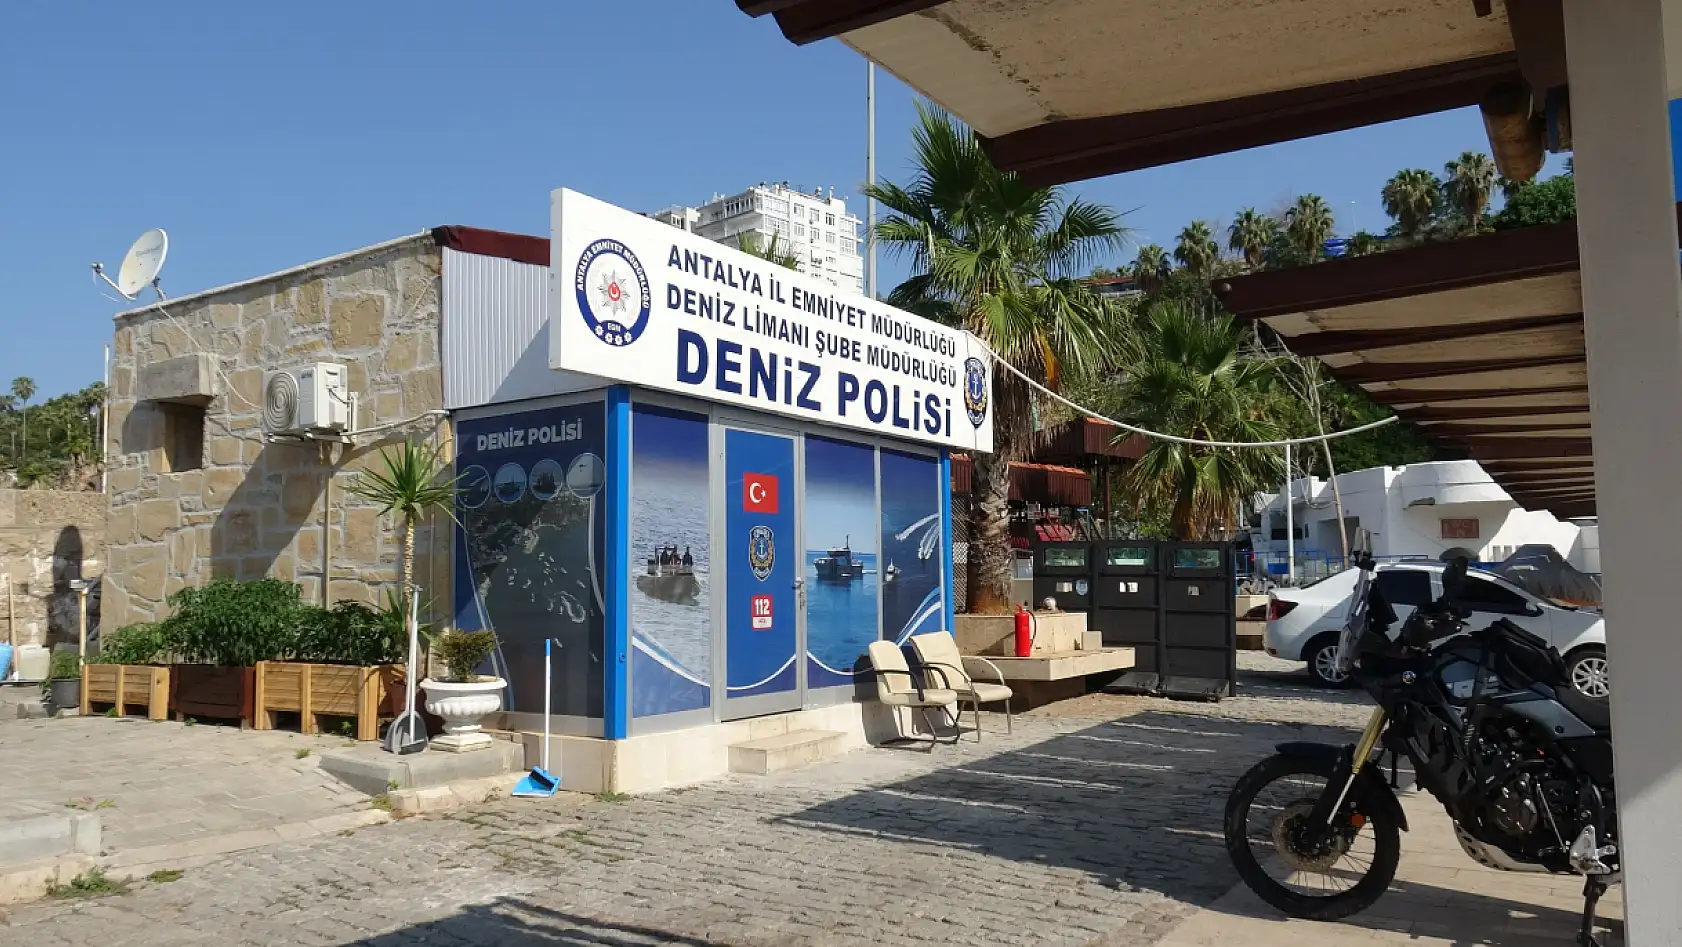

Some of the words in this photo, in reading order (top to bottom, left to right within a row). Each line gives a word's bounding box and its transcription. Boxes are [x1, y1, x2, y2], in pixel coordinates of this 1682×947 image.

[577, 250, 593, 291] ANTALYA
[667, 244, 763, 297] ANTALYA
[769, 273, 785, 304] İL
[792, 286, 866, 329] EMNİYET
[871, 313, 955, 358] MÜDÜRLÜĞÜ
[667, 283, 735, 327] DENİZ
[743, 304, 809, 348] LİMANI
[815, 330, 861, 362] ŞUBE
[867, 344, 957, 388] MÜDÜRLÜĞÜ
[477, 427, 524, 451] DENİZ
[528, 418, 582, 445] POLİSİ
[755, 599, 770, 615] 112
